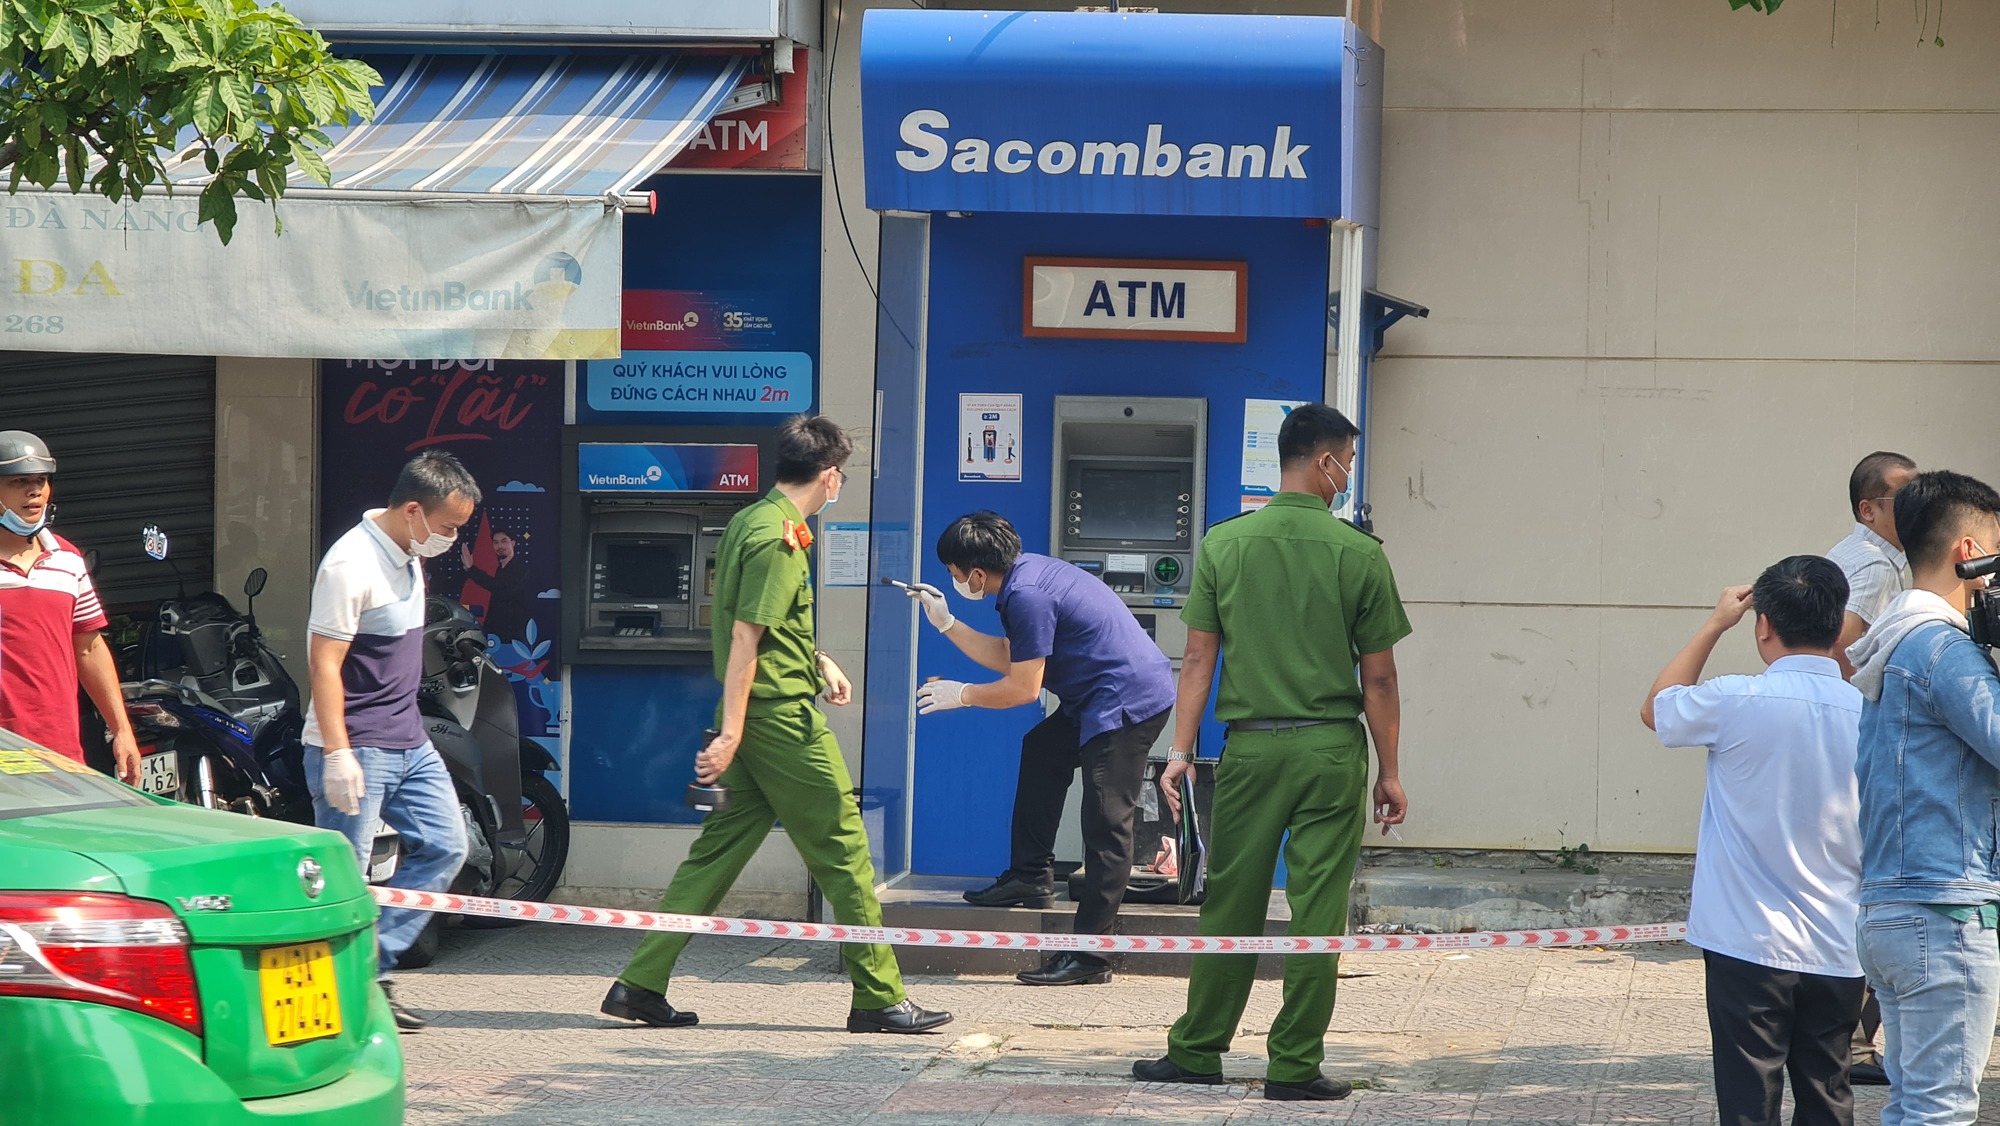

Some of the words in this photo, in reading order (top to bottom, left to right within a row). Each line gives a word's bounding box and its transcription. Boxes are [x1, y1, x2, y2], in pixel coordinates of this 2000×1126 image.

[689, 120, 768, 151] ATM
[895, 109, 1312, 179] Sacombank
[5, 200, 68, 229] ĐÀ
[12, 259, 125, 297] ĐA
[343, 280, 535, 312] VietinBank
[1083, 280, 1186, 319] ATM
[5, 314, 65, 334] 268
[626, 319, 685, 331] VietinBank
[723, 312, 744, 328] 35
[613, 361, 648, 378] QUÝ
[652, 361, 707, 379] KHÁCH
[712, 365, 738, 379] VUI
[743, 362, 788, 380] LÒNG
[611, 384, 658, 401] ĐỨNG
[662, 384, 708, 401] CÁCH
[713, 388, 757, 402] NHAU
[760, 385, 790, 402] 2m
[588, 474, 648, 485] VietinBank
[719, 474, 749, 486] ATM
